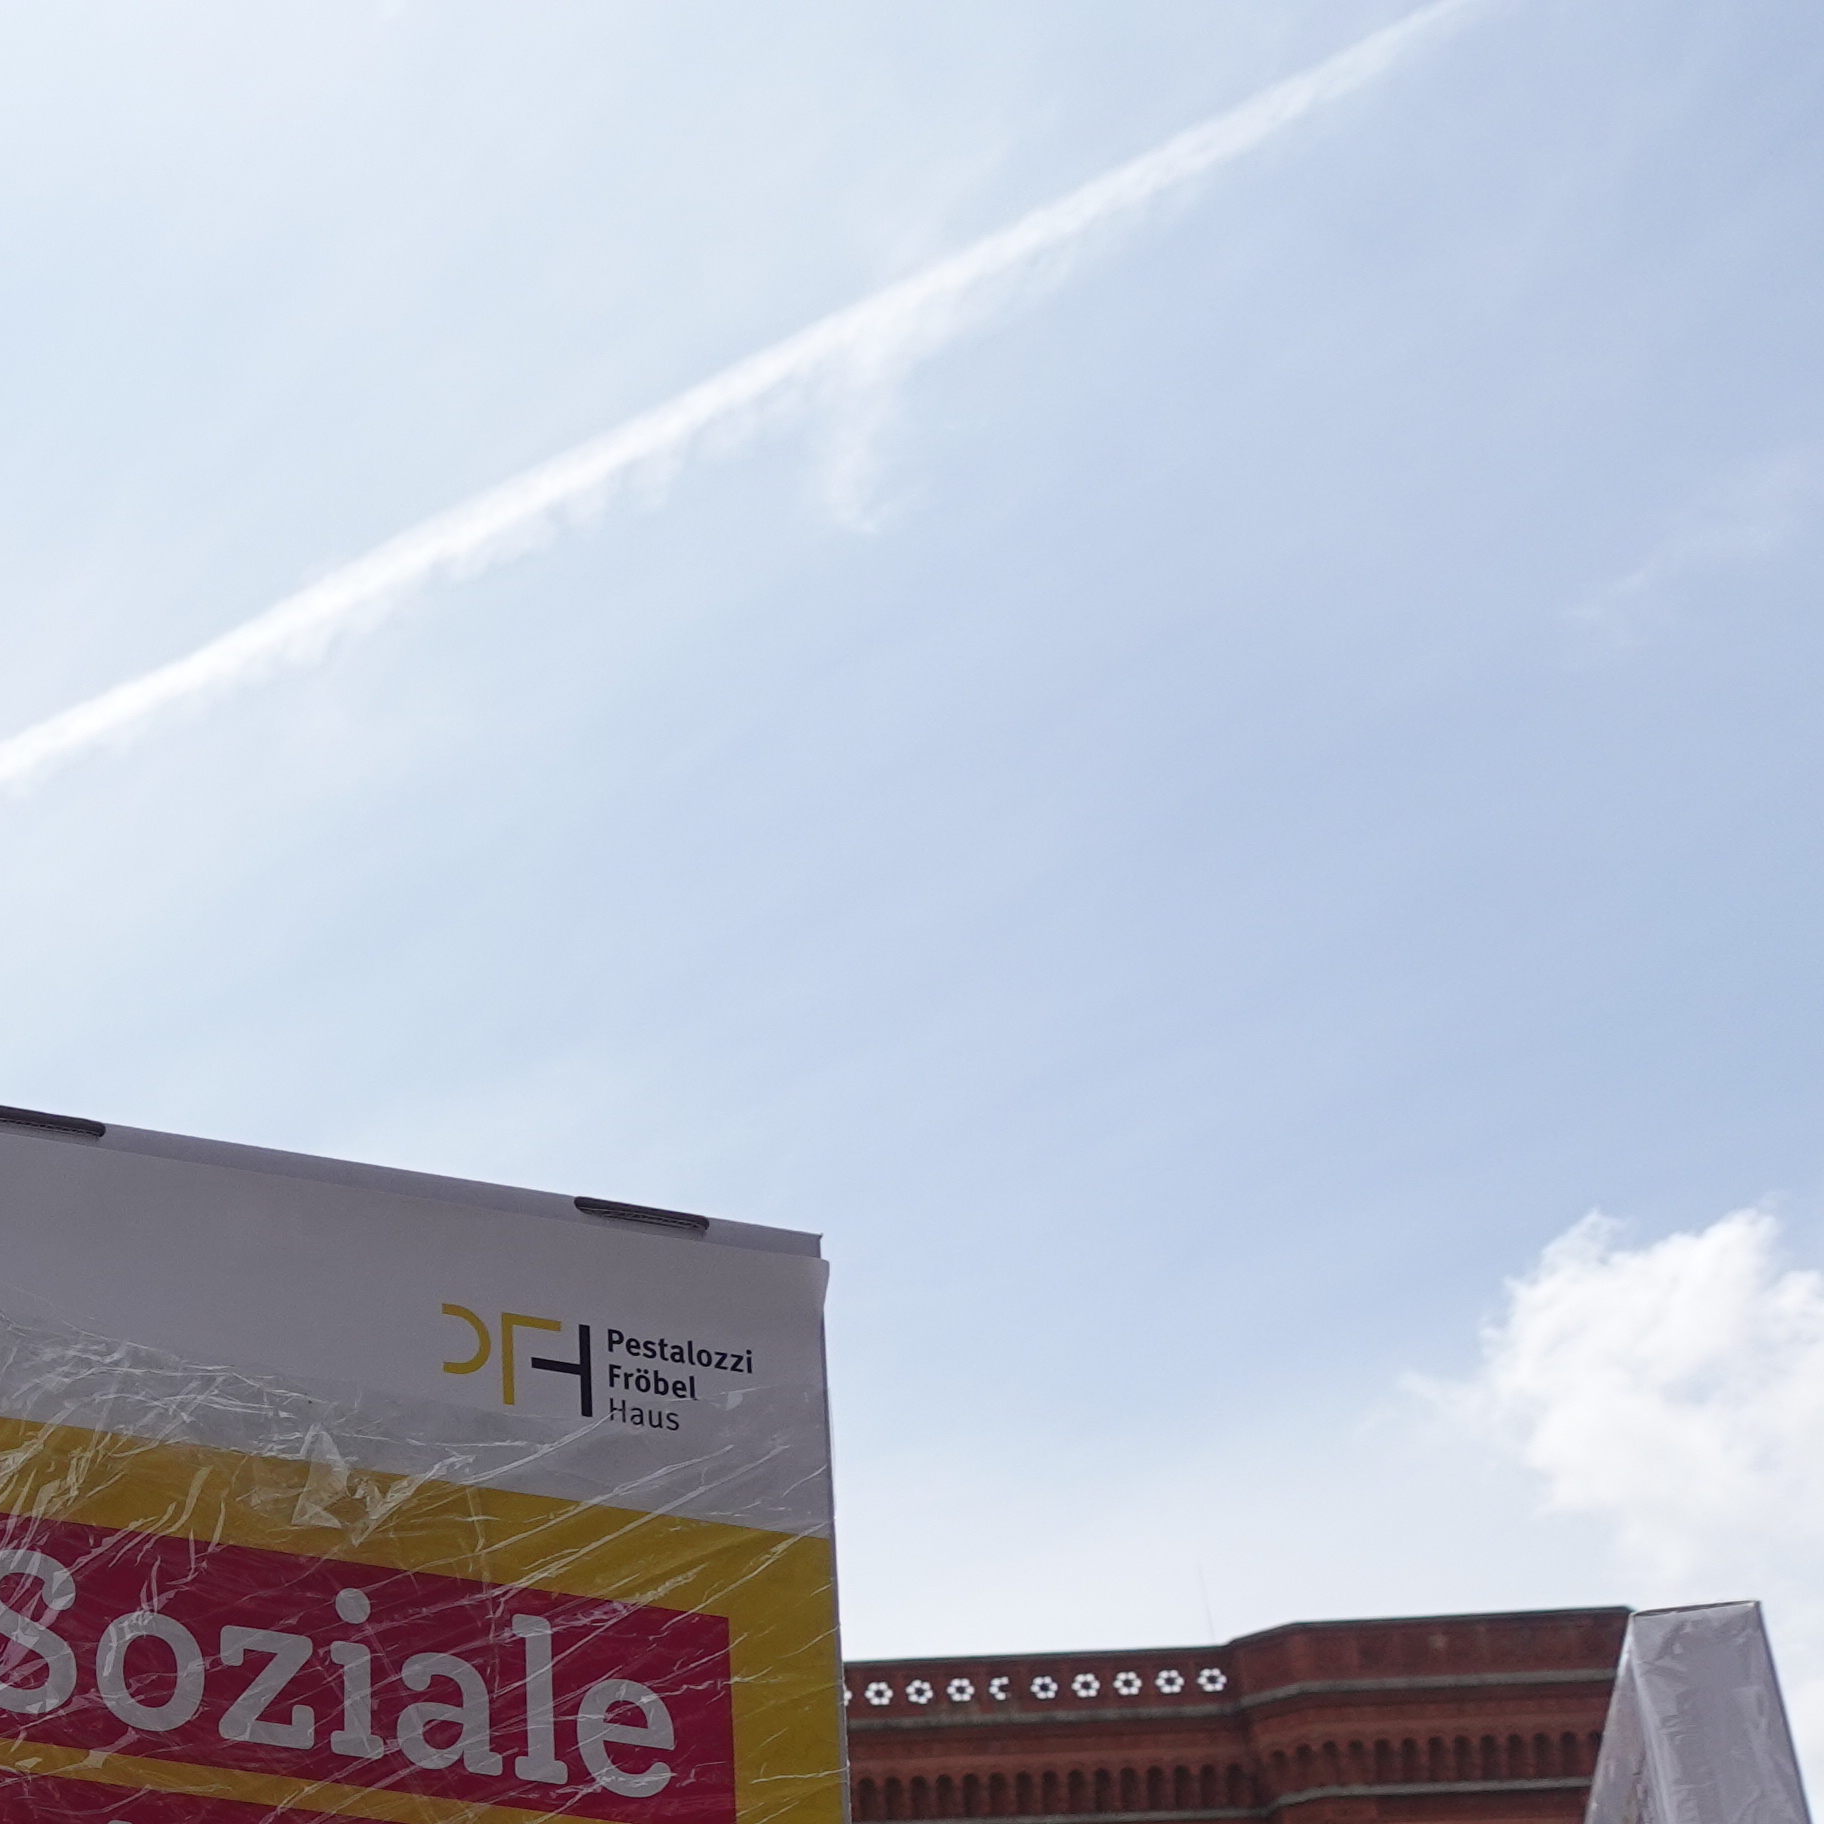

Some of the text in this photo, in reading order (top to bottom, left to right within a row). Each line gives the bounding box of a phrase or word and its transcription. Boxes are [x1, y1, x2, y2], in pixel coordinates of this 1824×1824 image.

[607, 1328, 753, 1375] Pestalozzi
[609, 1364, 699, 1401] Fröbel
[609, 1399, 680, 1432] Haus
